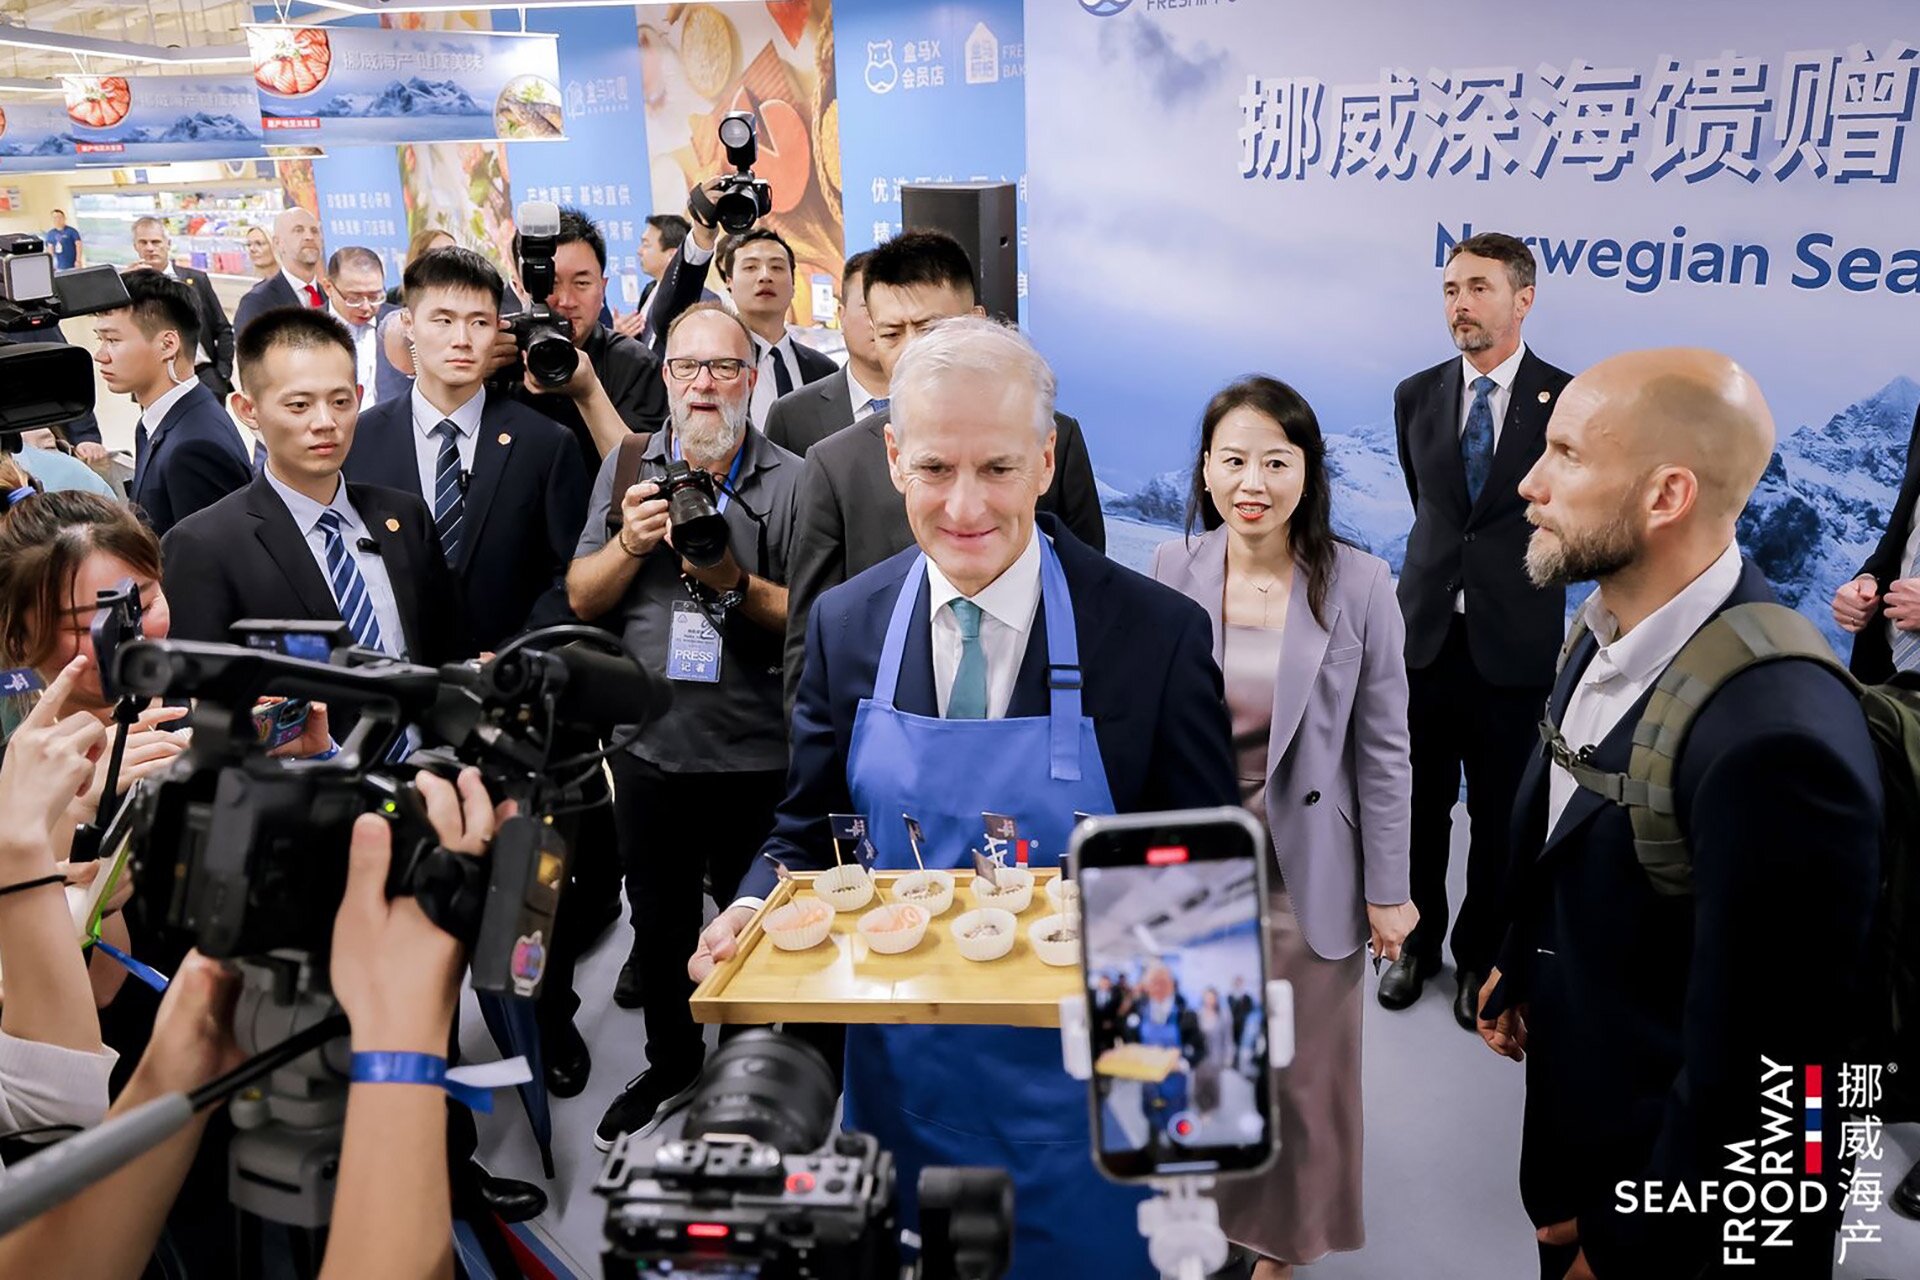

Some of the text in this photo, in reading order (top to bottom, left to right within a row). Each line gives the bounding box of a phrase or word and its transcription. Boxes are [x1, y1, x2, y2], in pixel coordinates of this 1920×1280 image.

[903, 40, 941, 63] 盒马X
[902, 66, 945, 89] 会员店
[1238, 40, 1919, 184] 挪威深海馈赠
[1791, 232, 1920, 295] Sea
[674, 649, 714, 663] PRESS
